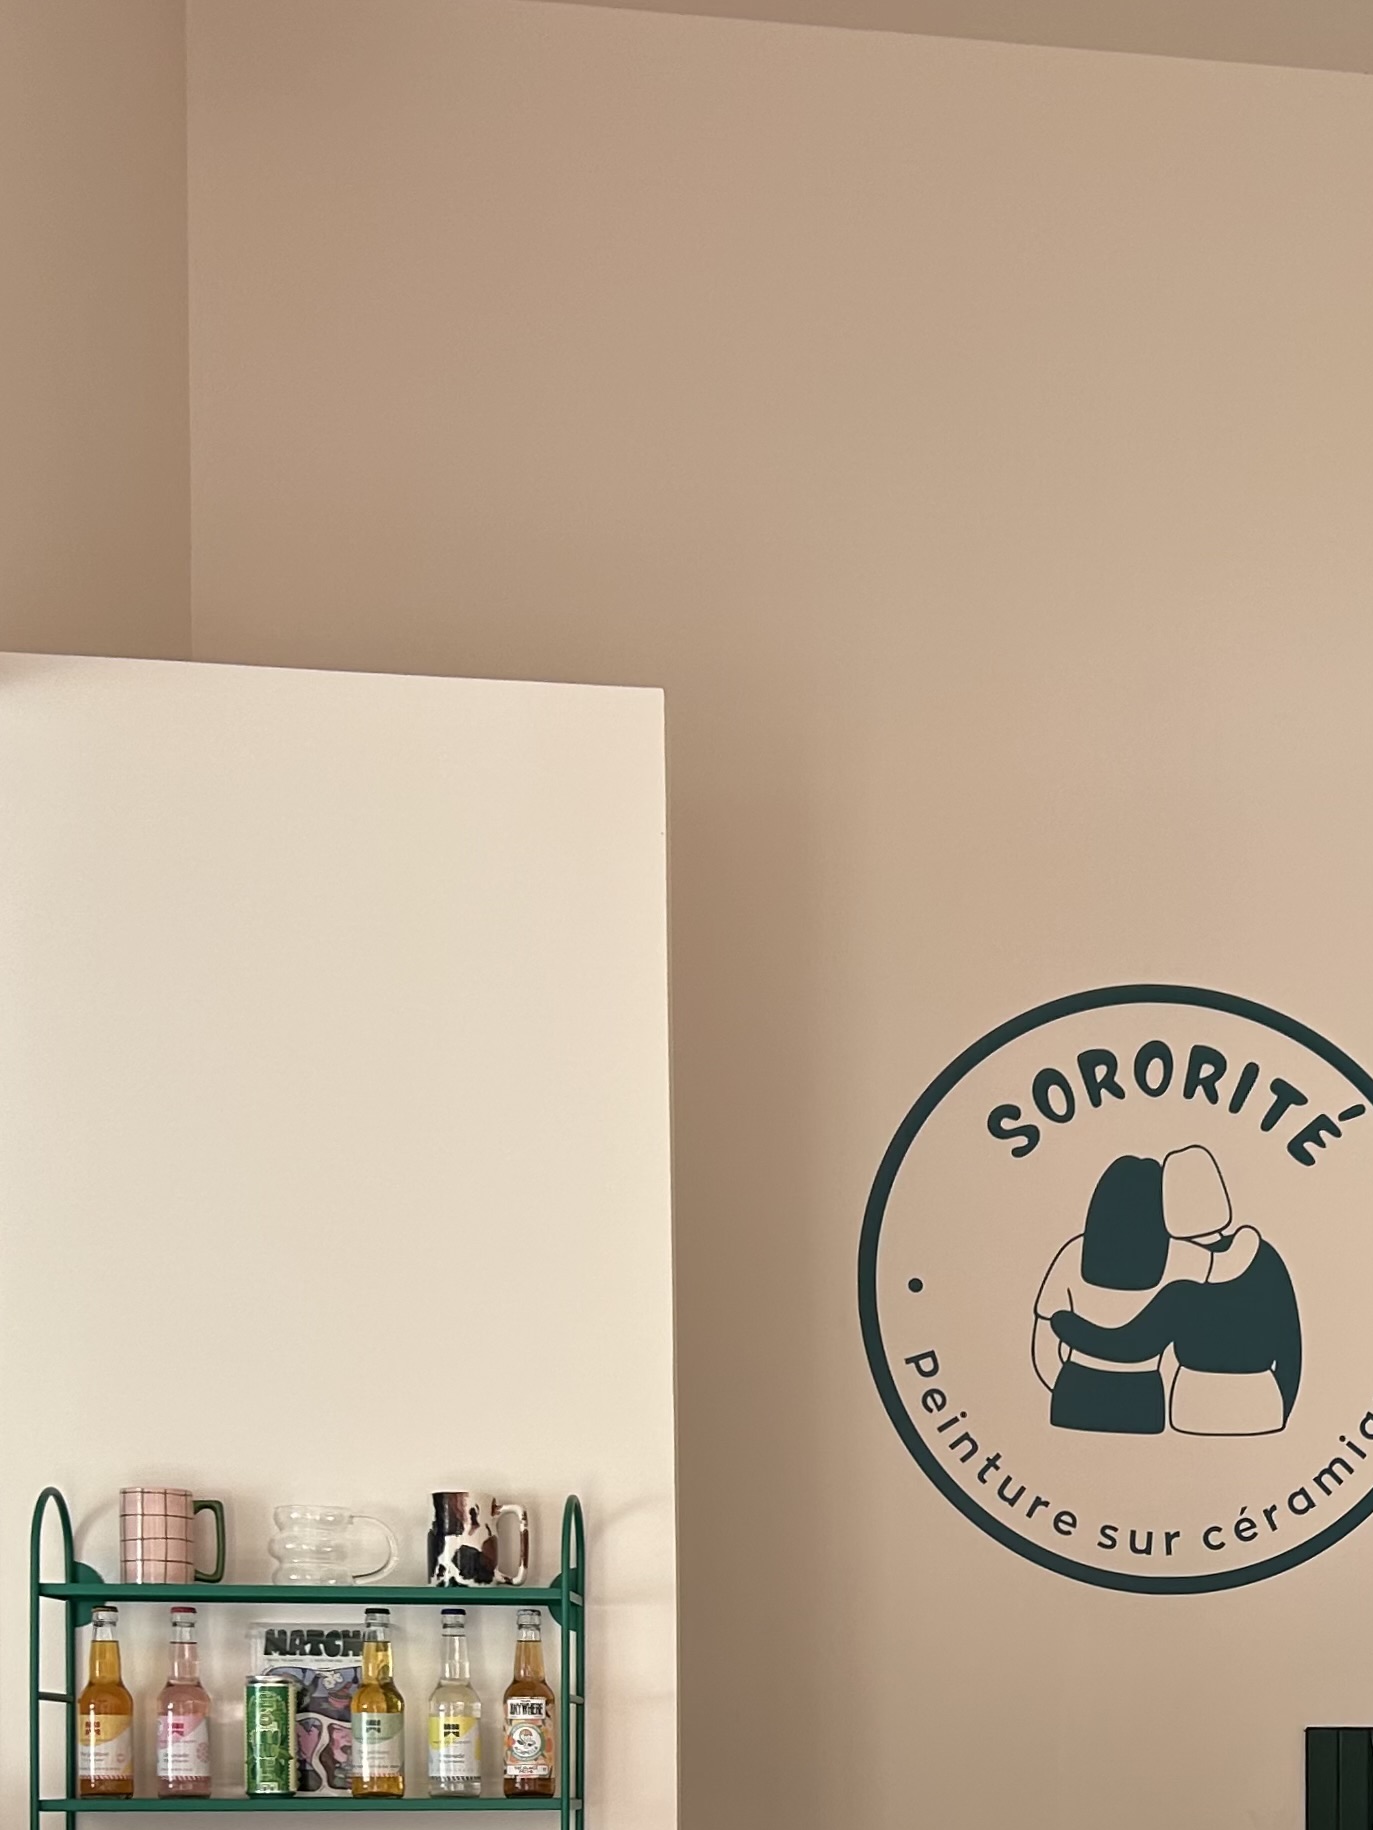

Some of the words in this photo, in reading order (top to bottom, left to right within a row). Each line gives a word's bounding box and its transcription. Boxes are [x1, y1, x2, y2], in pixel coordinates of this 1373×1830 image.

[987, 1040, 1366, 1167] SORORITÉ
[904, 1349, 1079, 1537] Peinture
[1097, 1523, 1181, 1557] sur
[264, 1629, 374, 1657] MATCH
